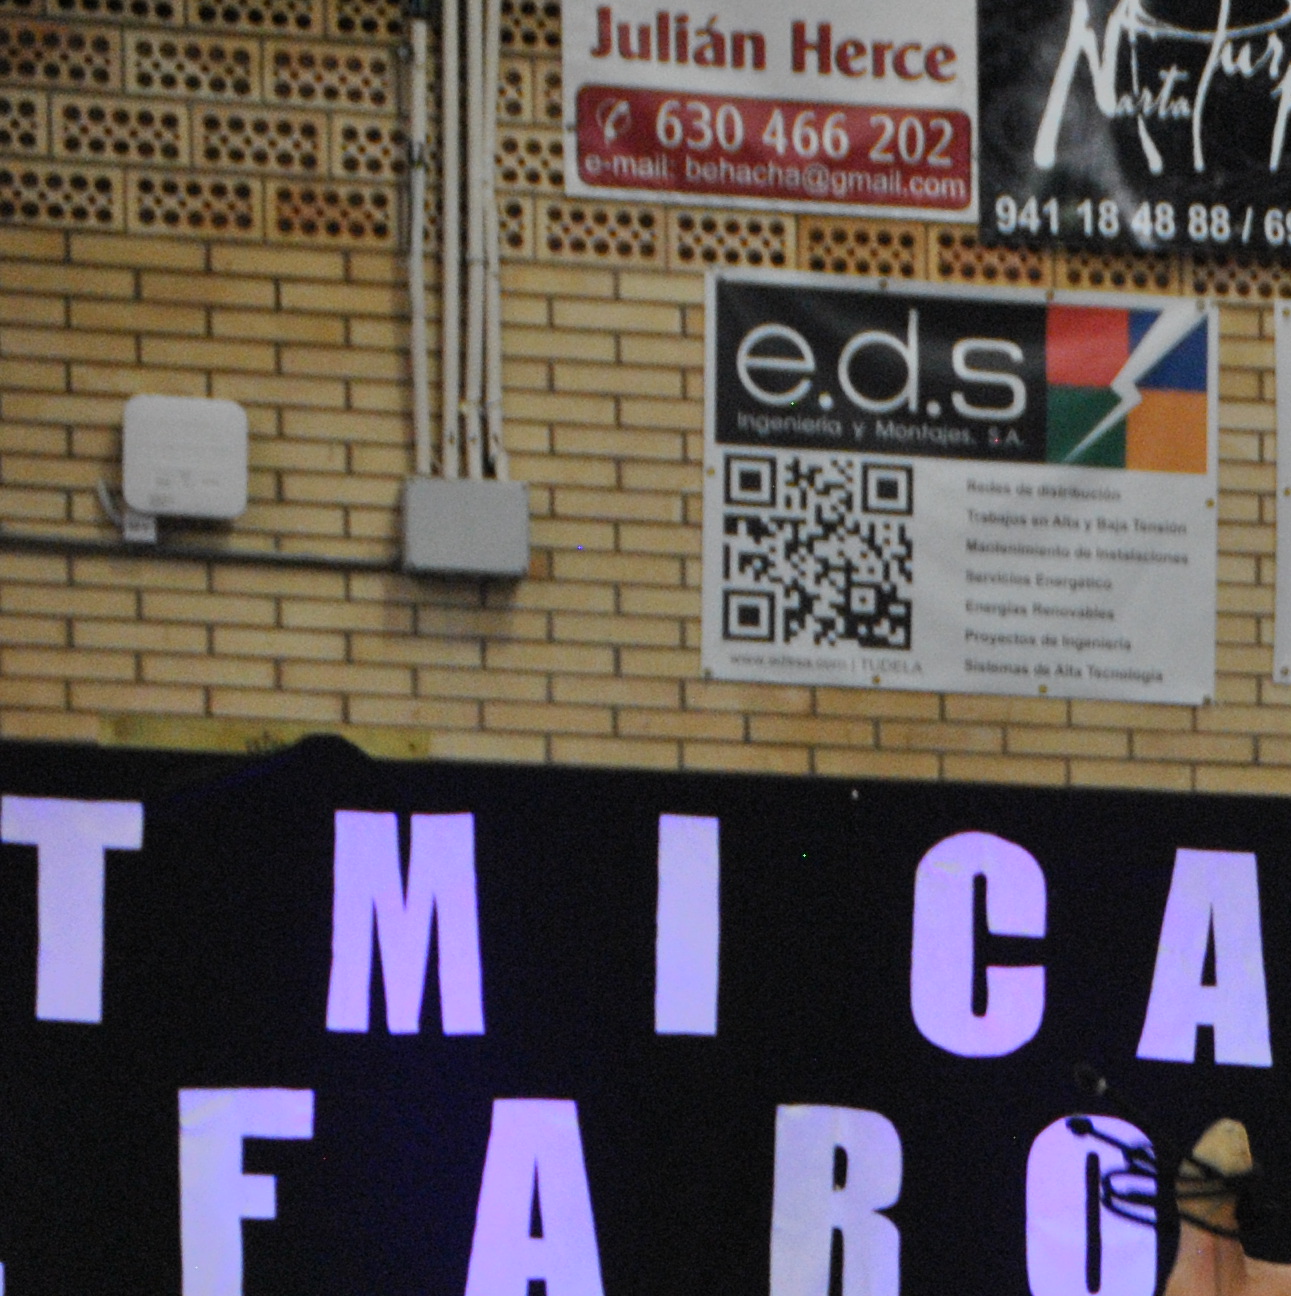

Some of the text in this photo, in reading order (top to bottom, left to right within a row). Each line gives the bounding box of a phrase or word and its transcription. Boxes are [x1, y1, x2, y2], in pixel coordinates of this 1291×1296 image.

[590, 5, 957, 82] Julián Herce
[655, 99, 954, 166] 630 466 202
[685, 154, 967, 198] behacha@gmail.com
[995, 195, 1060, 236] 941
[1076, 199, 1120, 237] 18
[1132, 200, 1176, 241] 48
[1188, 204, 1231, 243] 88
[736, 308, 1026, 419] e.d.s
[852, 421, 866, 440] y
